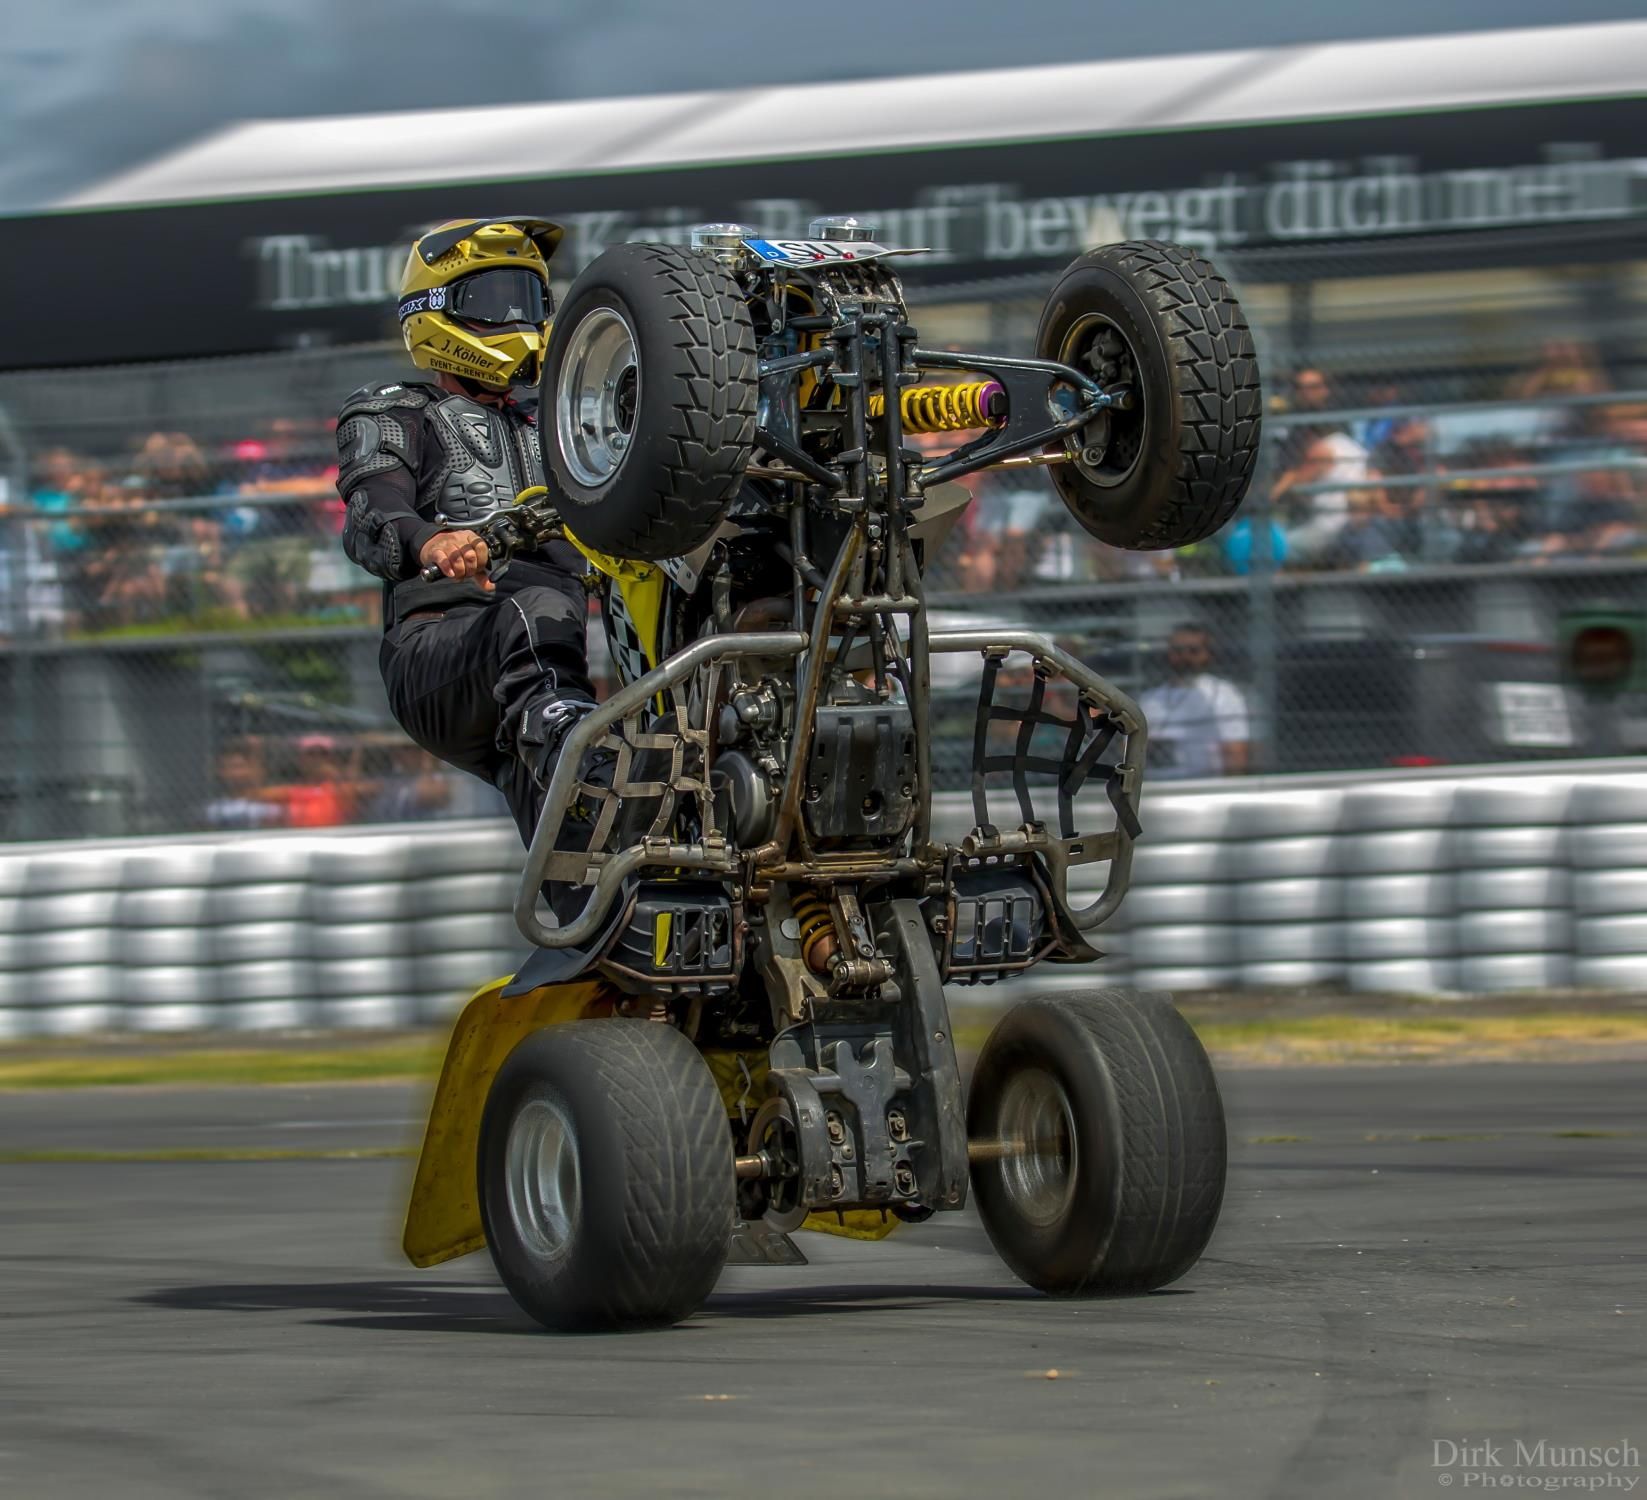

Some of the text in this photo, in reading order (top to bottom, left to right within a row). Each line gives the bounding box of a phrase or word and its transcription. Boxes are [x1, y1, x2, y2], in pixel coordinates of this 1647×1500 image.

[441, 340, 495, 369] J. Köhler
[430, 358, 501, 383] EVENT-4-RENT.DE
